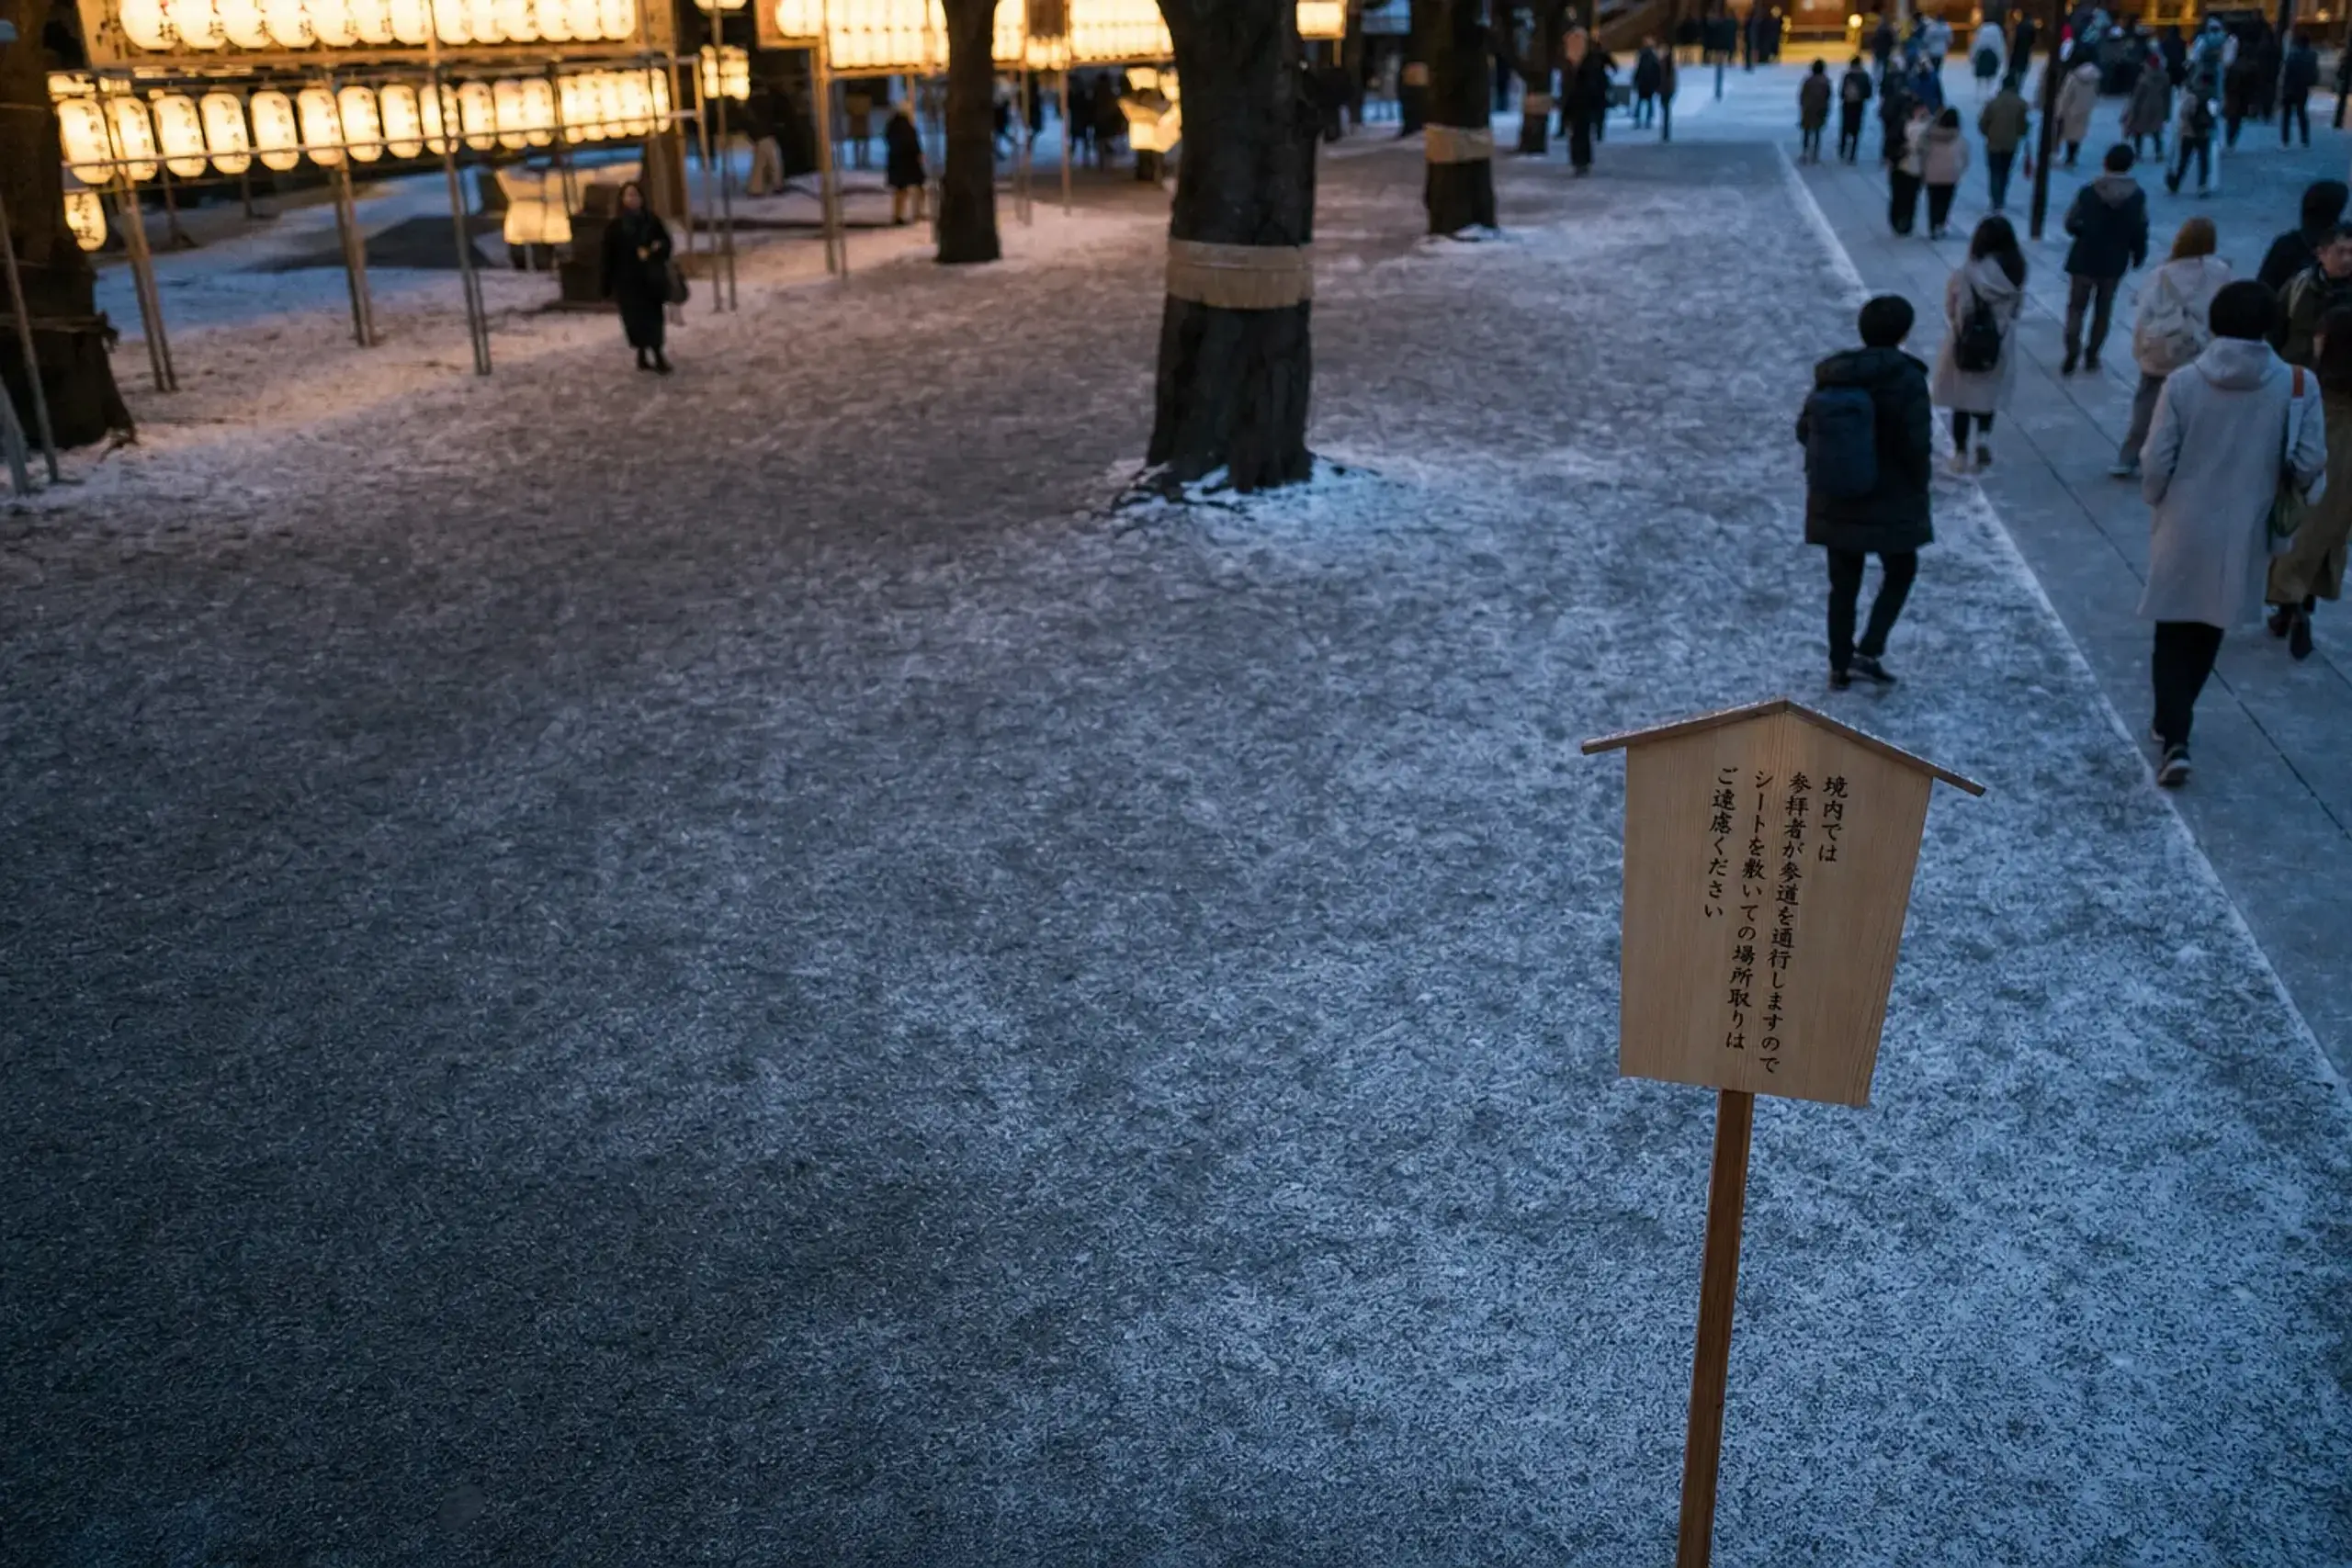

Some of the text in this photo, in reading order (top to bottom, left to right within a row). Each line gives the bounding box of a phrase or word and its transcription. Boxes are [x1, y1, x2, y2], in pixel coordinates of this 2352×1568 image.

[1704, 766, 1738, 918] ご遠慮ください
[1725, 770, 1774, 1050] シートを敷いての場所取りは
[1759, 772, 1812, 1074] 参拝者が参道を通行しますので
[1818, 775, 1849, 863] 境内では
